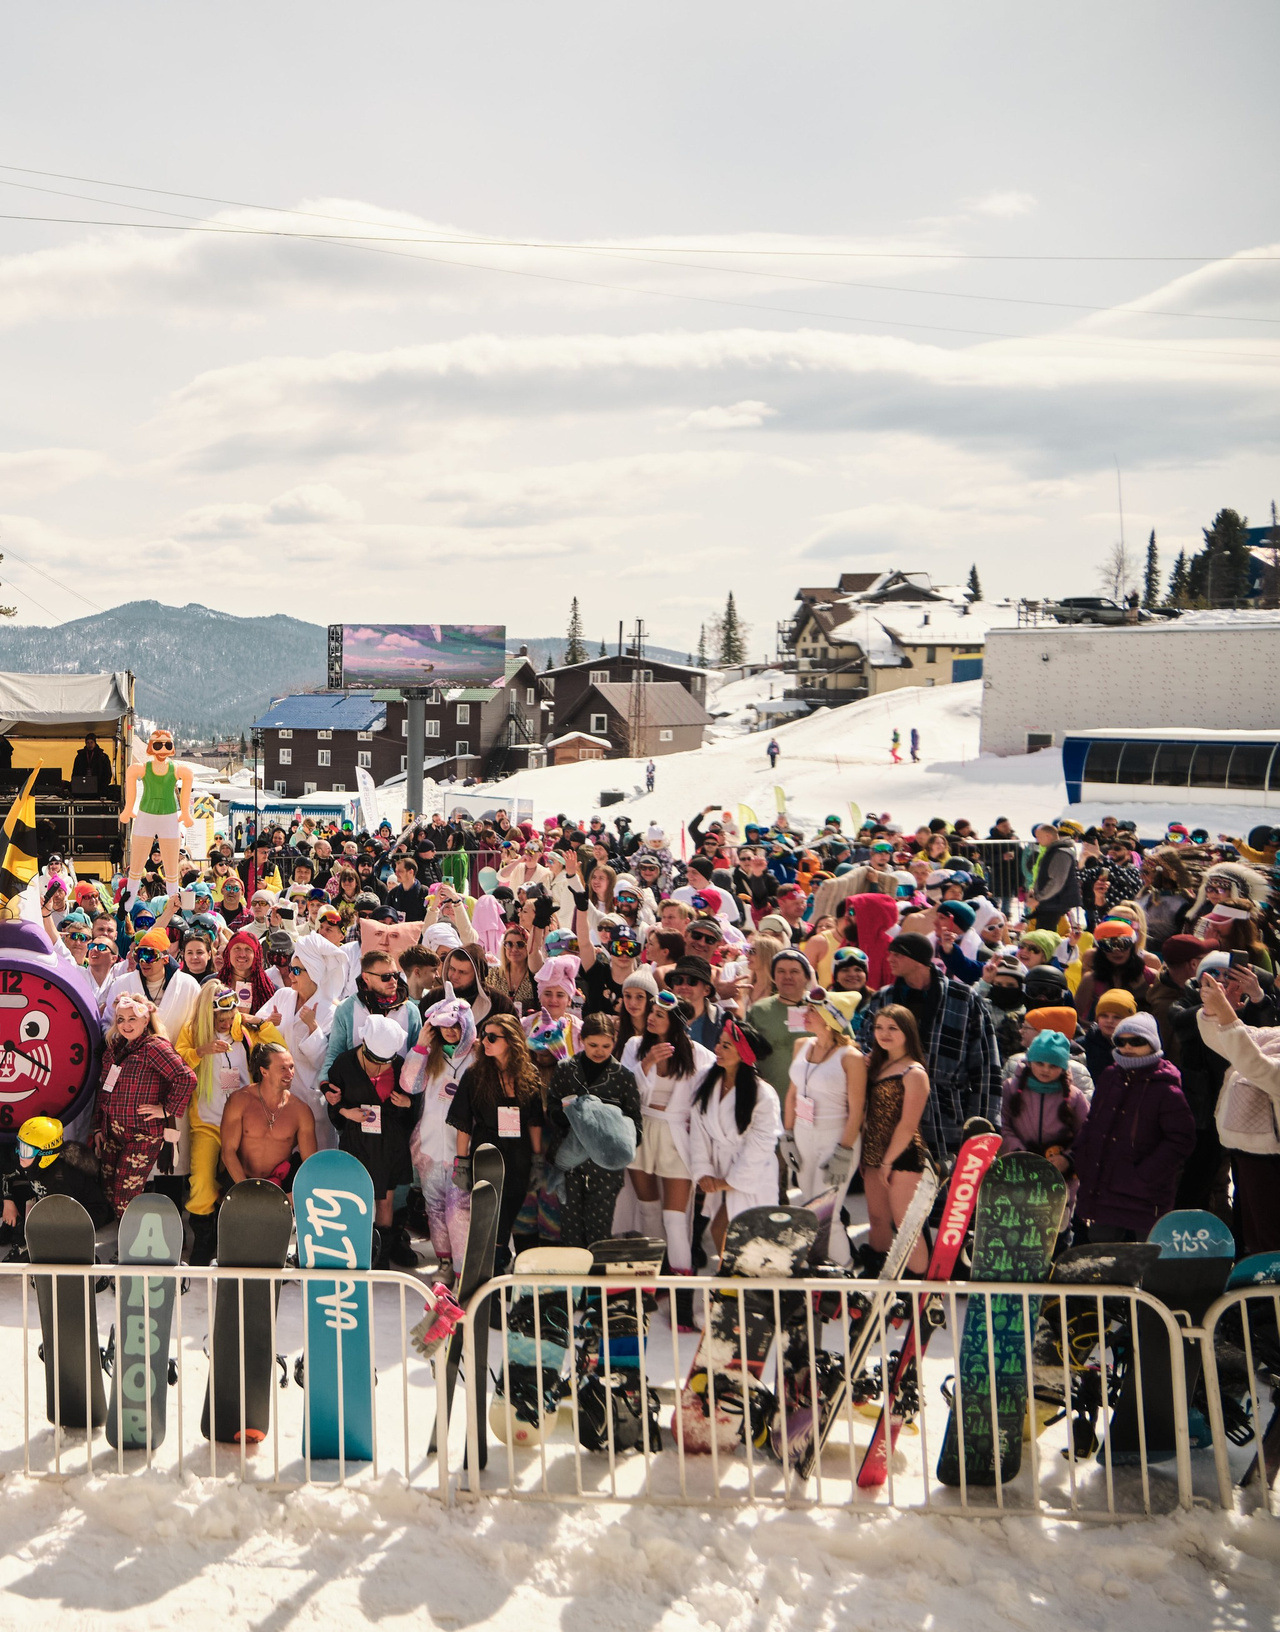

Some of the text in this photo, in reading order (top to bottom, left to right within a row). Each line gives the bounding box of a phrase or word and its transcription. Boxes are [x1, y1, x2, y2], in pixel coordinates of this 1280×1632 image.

[2, 972, 23, 993] 12
[70, 1043, 84, 1066] 3
[0, 1104, 15, 1126] 6
[942, 1153, 984, 1246] ATOMIC
[121, 1212, 171, 1444] ARBOR
